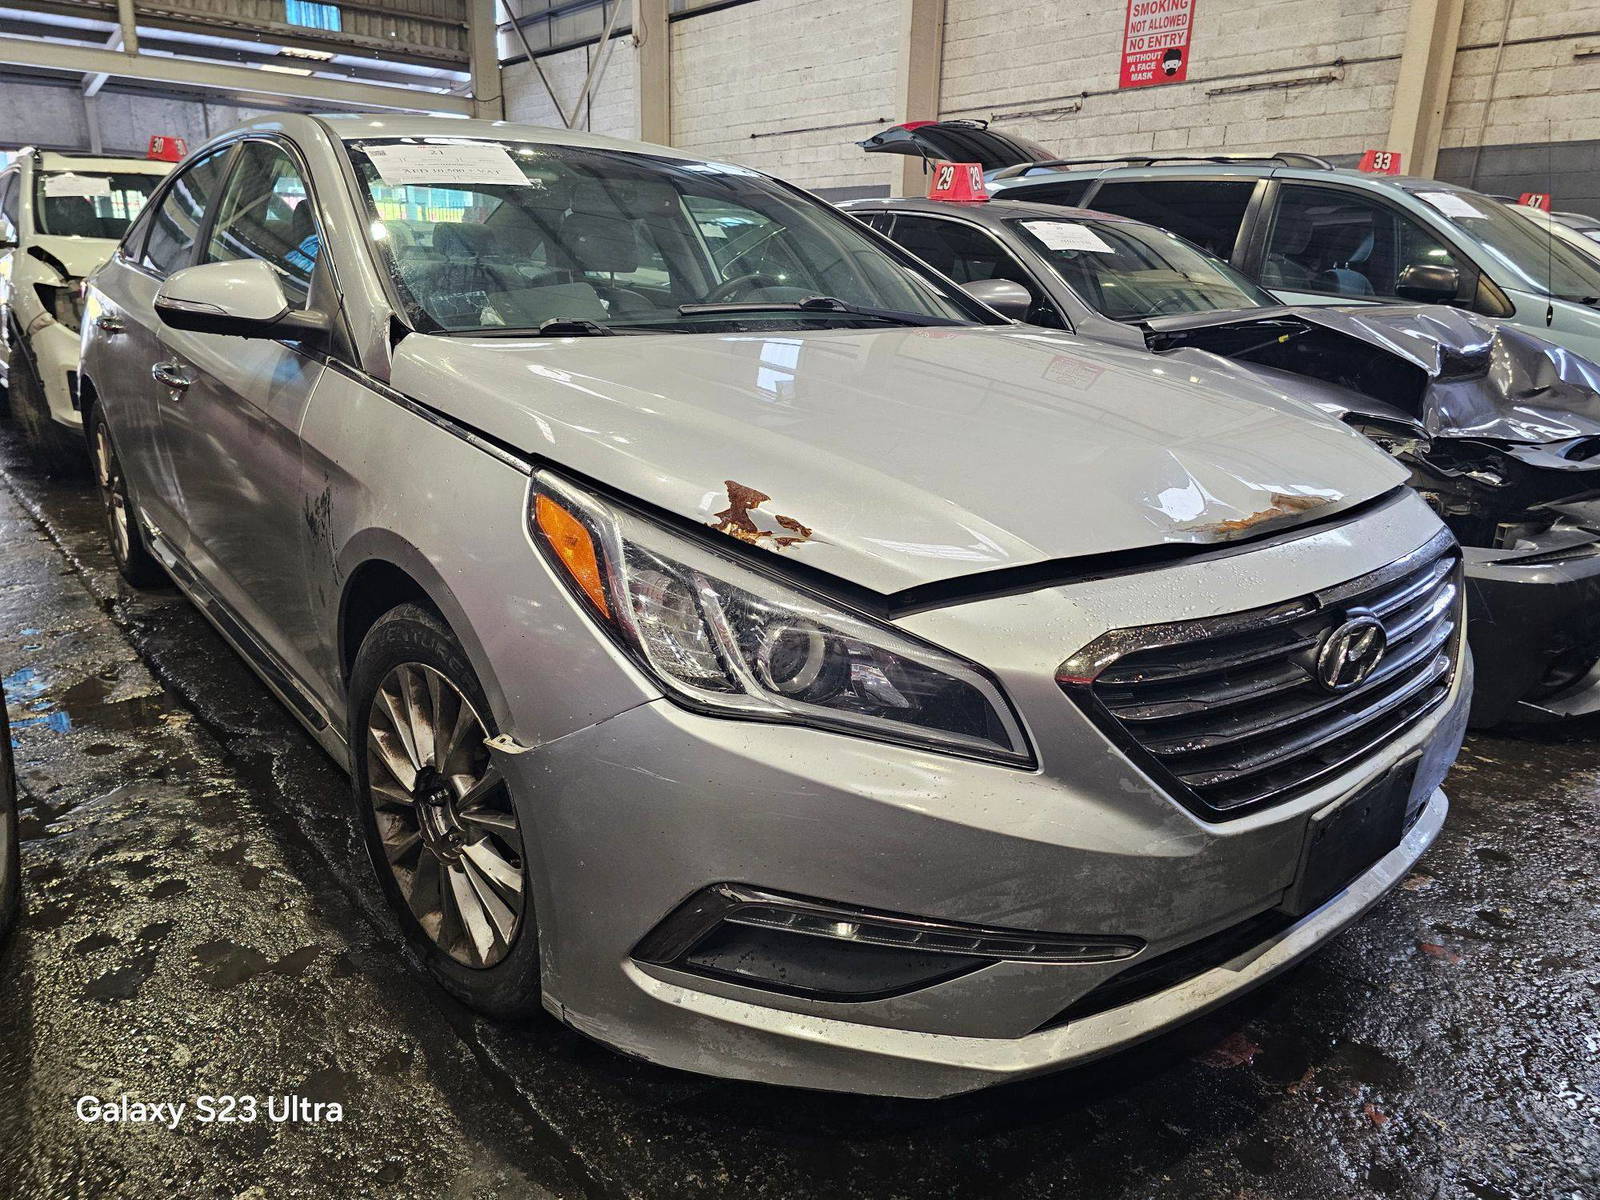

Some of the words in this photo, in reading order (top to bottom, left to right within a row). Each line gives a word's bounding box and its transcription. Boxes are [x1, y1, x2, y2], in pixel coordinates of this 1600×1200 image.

[1133, 0, 1188, 17] SMOKING
[1130, 20, 1146, 33] NOT
[1148, 13, 1187, 30] ALLOWED
[1130, 38, 1144, 50] NO
[1148, 32, 1184, 48] ENTRY
[1127, 51, 1162, 63] WITHOUT
[1130, 64, 1135, 72] A
[1137, 61, 1156, 71] FACE
[1131, 71, 1153, 81] MASK
[152, 137, 164, 153] 30
[1373, 152, 1392, 169] 33
[937, 166, 955, 190] 29
[970, 166, 983, 190] 29
[1527, 194, 1543, 208] 47
